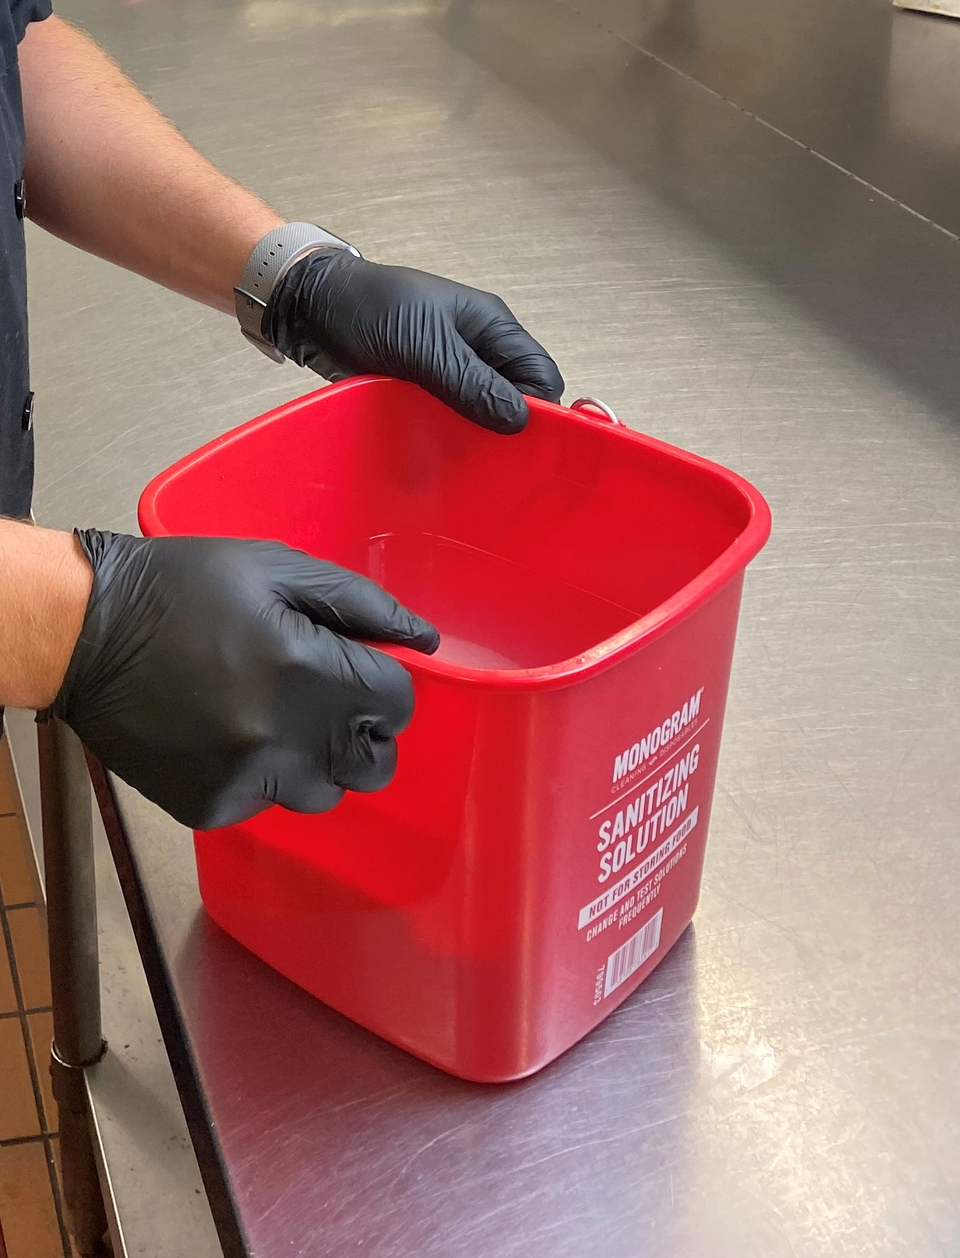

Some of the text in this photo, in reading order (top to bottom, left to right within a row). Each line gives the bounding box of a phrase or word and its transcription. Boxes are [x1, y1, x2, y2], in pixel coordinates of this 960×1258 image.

[612, 689, 701, 783] MONOGRAM
[596, 743, 700, 852] SANITIZING
[597, 782, 689, 883] SOLUTION
[586, 843, 687, 943] CHANGE AND TEST SOLUTIONS
[588, 818, 692, 920] NOT FOR STORING FOOD
[618, 882, 661, 931] FREQUENTLY
